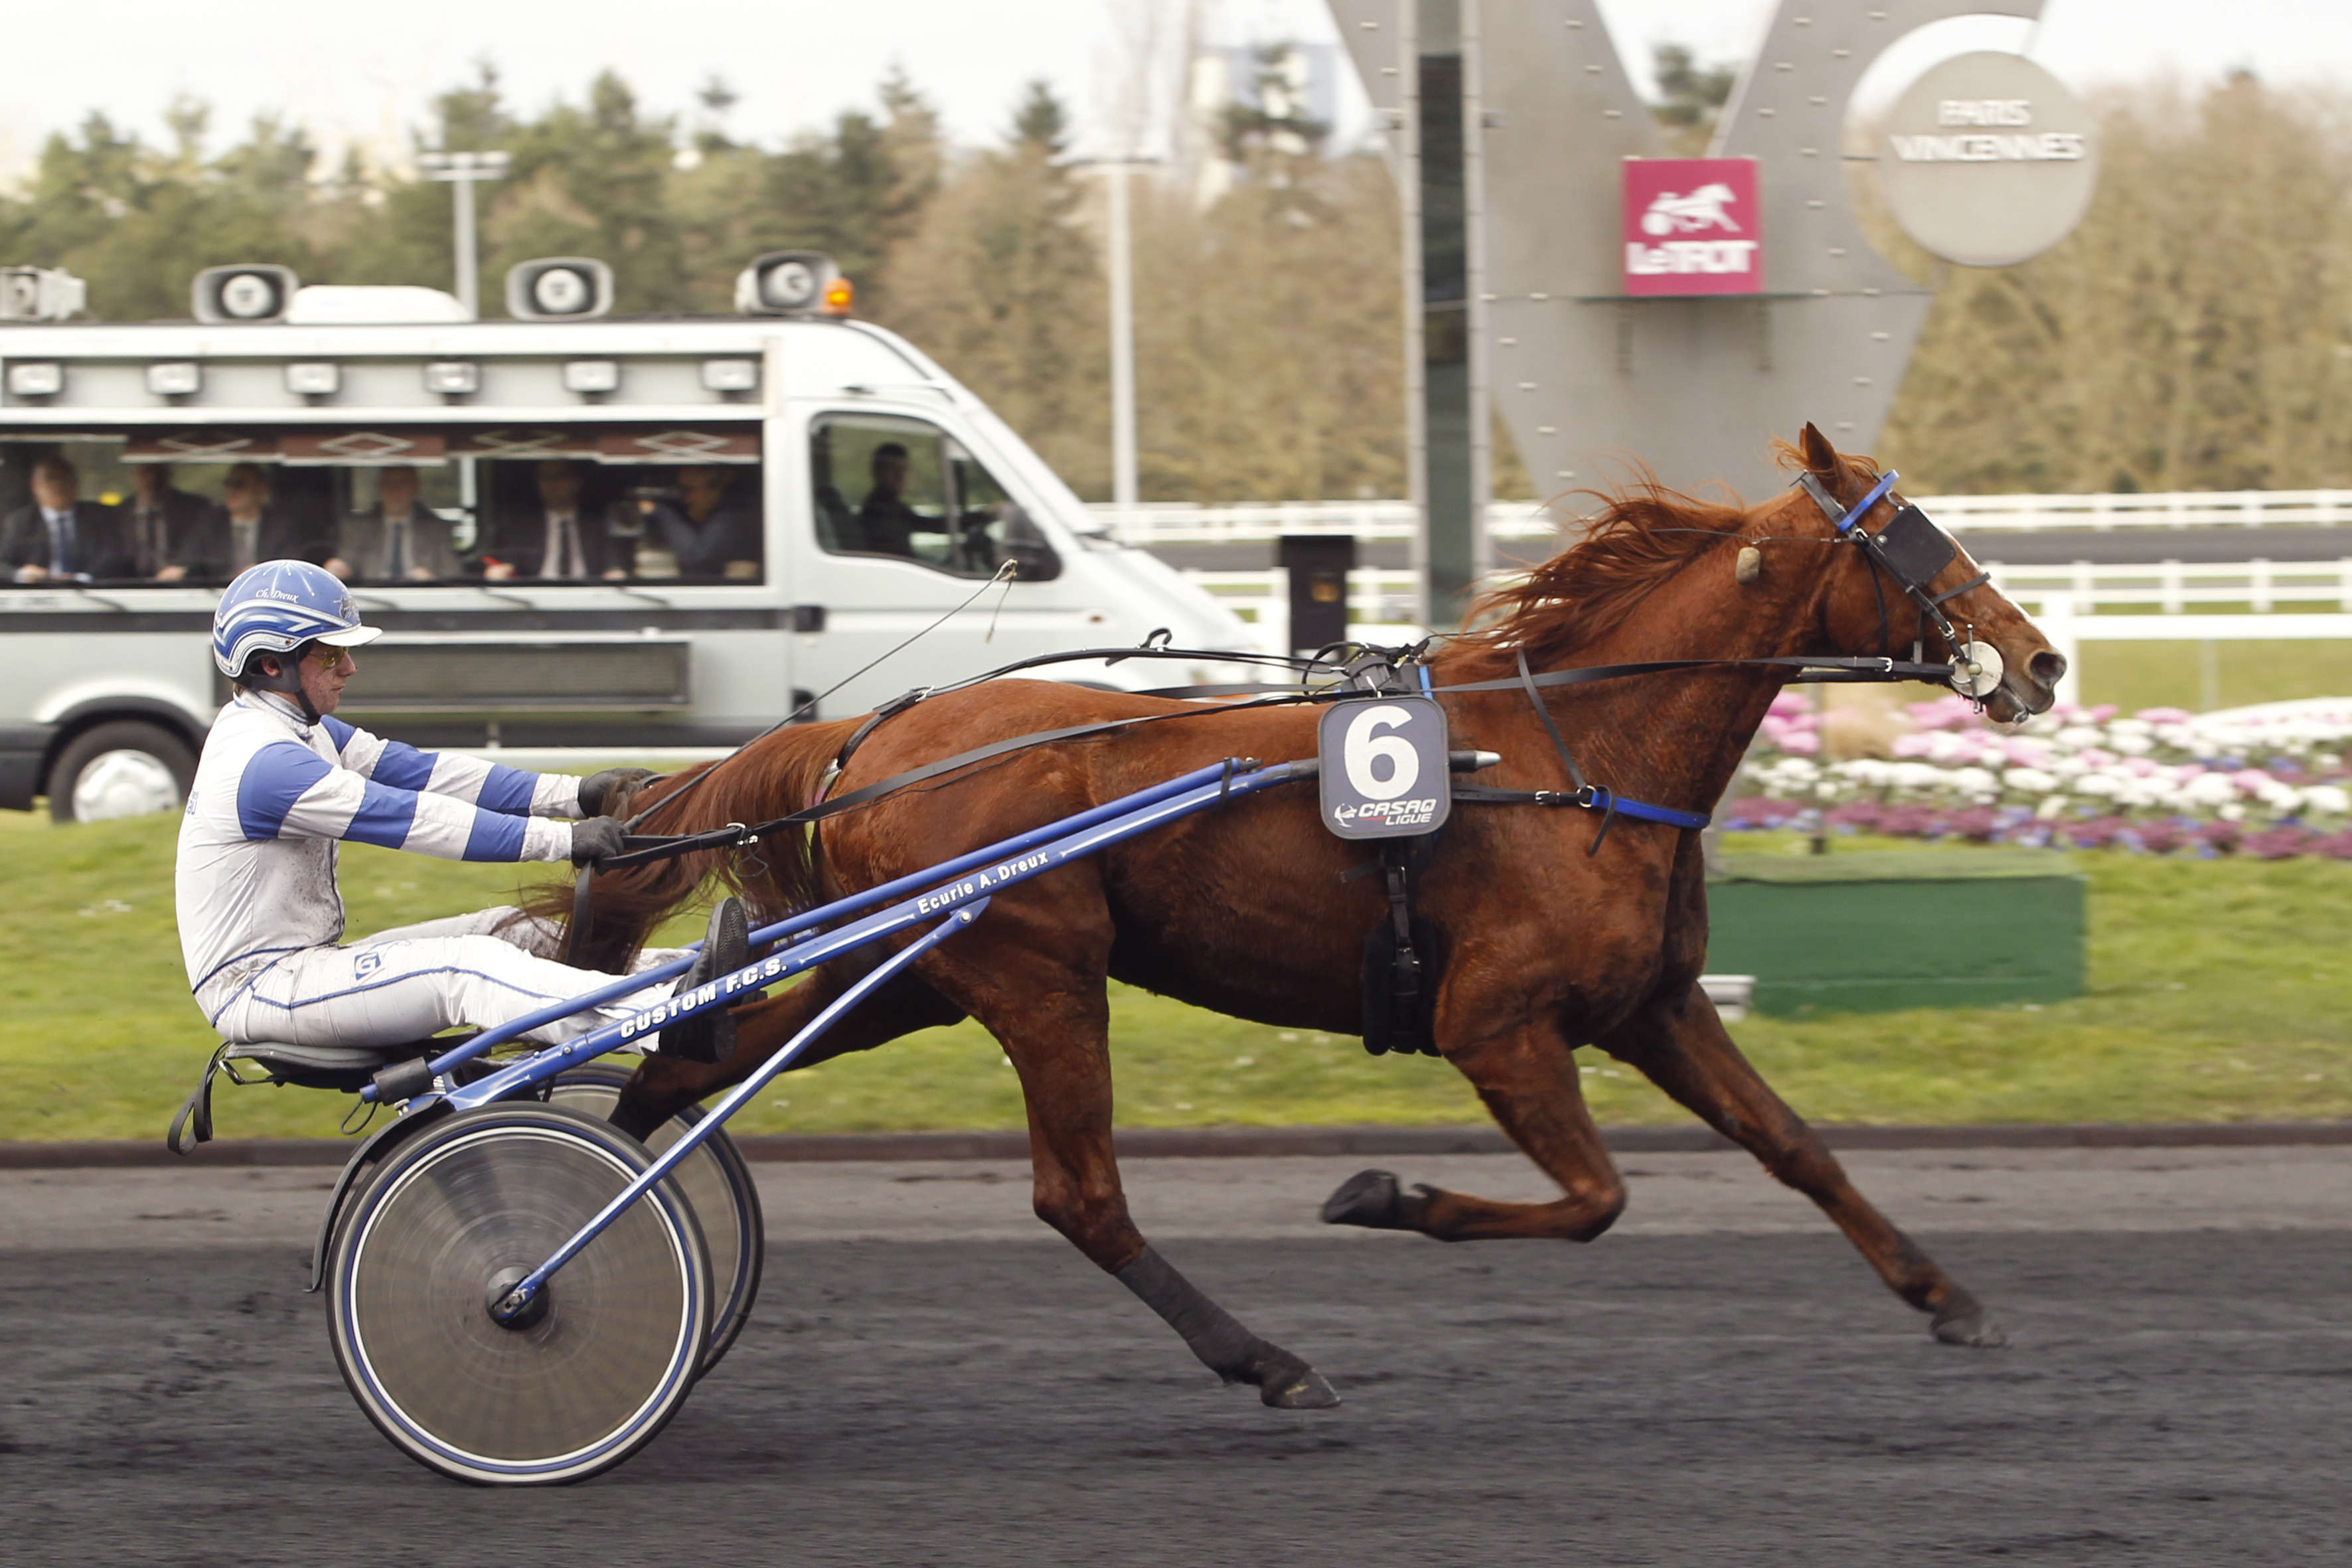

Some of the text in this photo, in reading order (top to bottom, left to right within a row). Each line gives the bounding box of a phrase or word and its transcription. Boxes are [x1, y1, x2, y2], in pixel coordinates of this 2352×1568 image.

[1938, 100, 2031, 127] PARIS
[1889, 133, 2086, 161] VINCENNES
[274, 590, 299, 604] Dreux
[1344, 705, 1419, 801] 6
[1358, 798, 1437, 818] CASAQ
[1385, 813, 1433, 825] LIGUE
[917, 882, 975, 915] Ecurie
[620, 957, 788, 1039] CUSTOM F.C.S.
